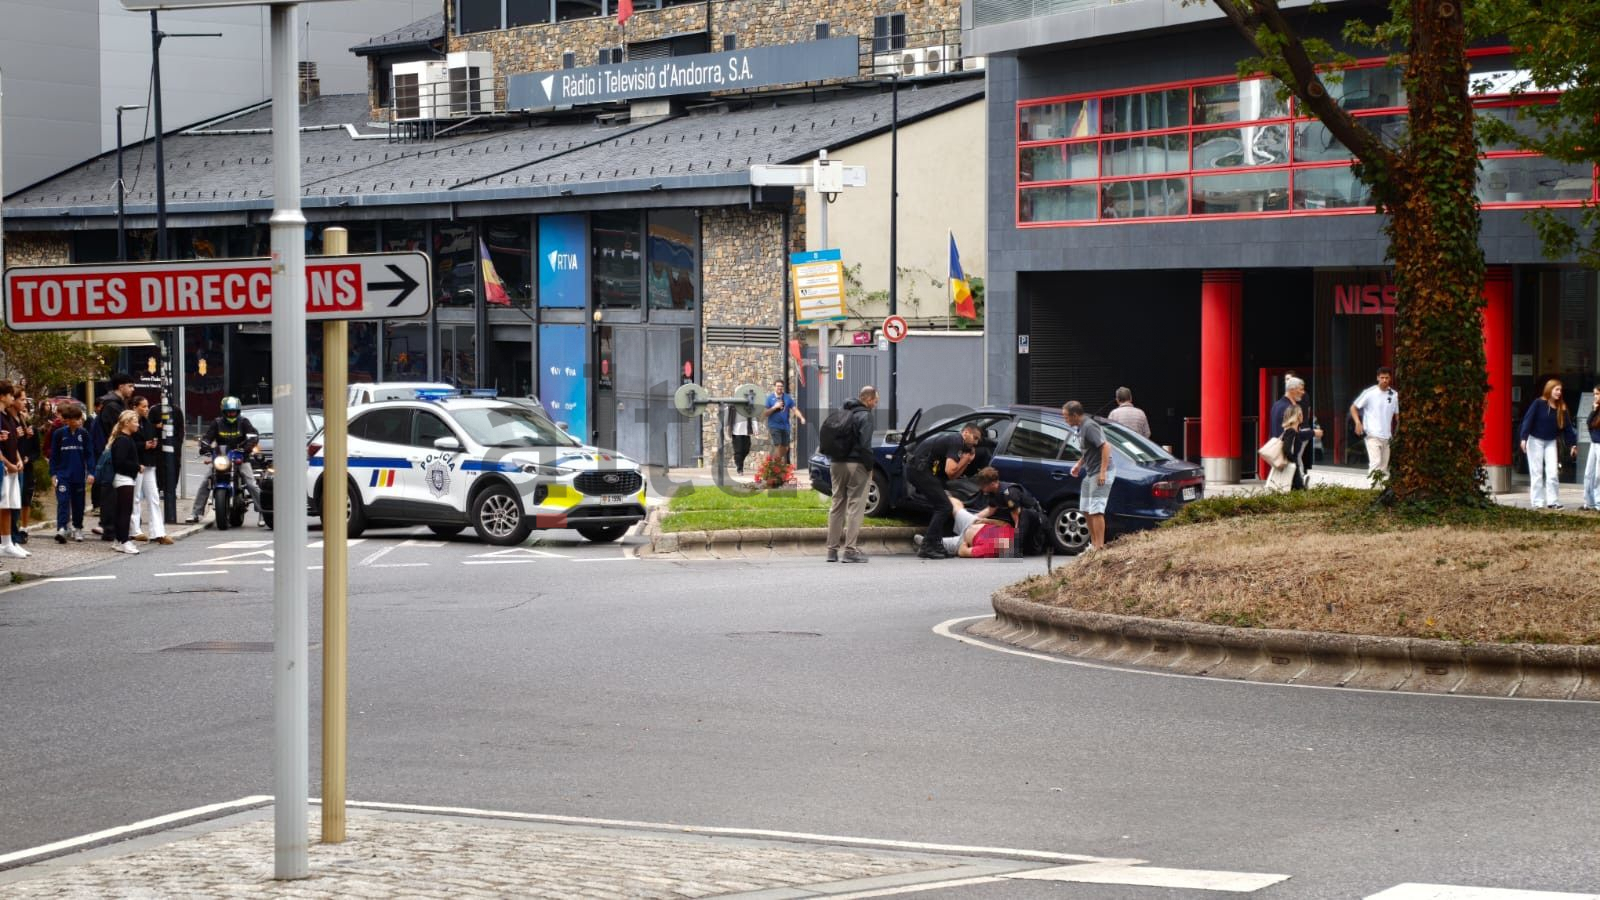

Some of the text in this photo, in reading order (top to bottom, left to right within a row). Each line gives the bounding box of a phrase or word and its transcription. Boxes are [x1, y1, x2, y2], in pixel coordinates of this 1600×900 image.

[563, 73, 595, 98] Ràdio
[598, 72, 602, 94] i
[604, 66, 656, 93] Televisió
[729, 56, 753, 81] S.A.
[557, 253, 578, 270] RTVA
[17, 268, 357, 317] TOTES DIRECCNS
[1335, 284, 1398, 314] NISS
